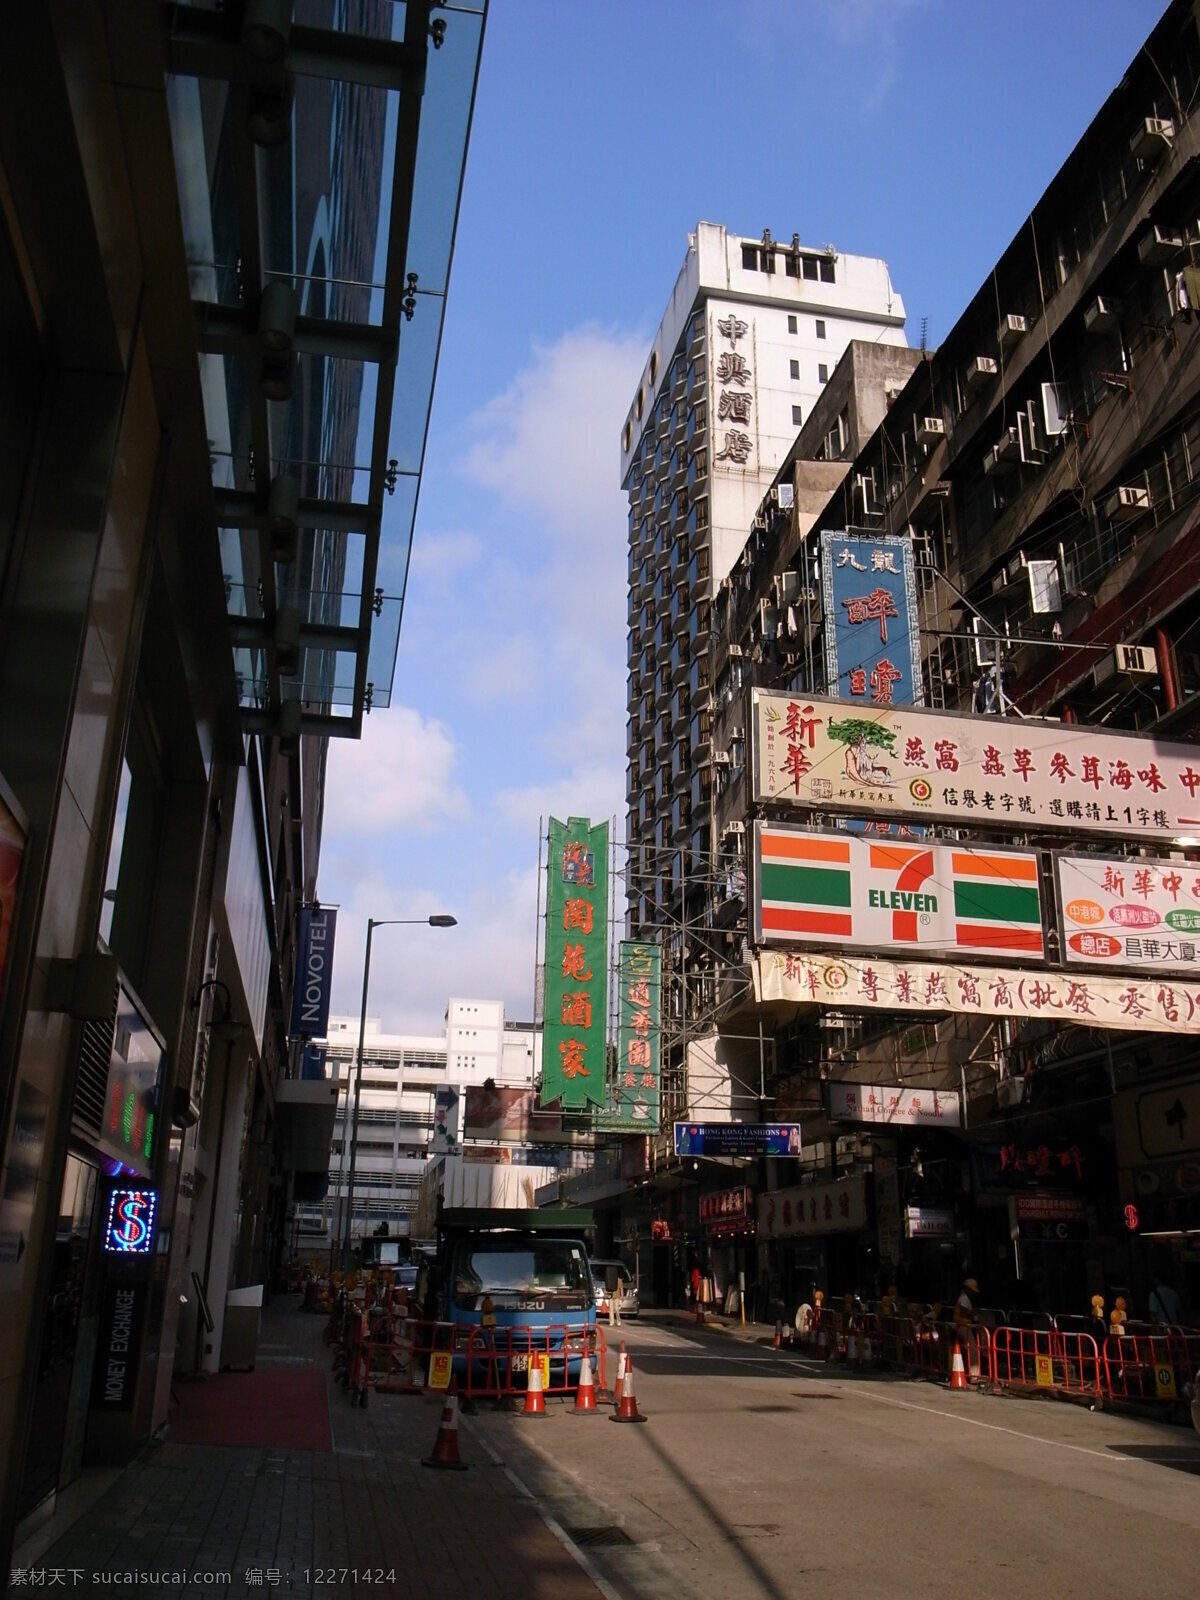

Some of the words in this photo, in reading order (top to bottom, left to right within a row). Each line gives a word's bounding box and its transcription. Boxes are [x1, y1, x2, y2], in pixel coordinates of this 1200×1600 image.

[779, 701, 823, 796] 新華
[903, 736, 960, 773] 燕窩
[981, 744, 1037, 783] 蟲草
[1049, 752, 1167, 794] 參茸海味
[1069, 905, 1101, 920] 中港城
[301, 914, 328, 1022] NOVOTEL
[1080, 935, 1111, 956] 總店
[1125, 937, 1200, 962] 昌華大廈
[782, 954, 822, 999] 新華
[846, 1104, 875, 1113] Nathan
[877, 1106, 906, 1117] Congee
[699, 1128, 722, 1136] HONG
[744, 1129, 780, 1137] FASHIONS
[110, 1288, 136, 1352] EXCHANGE
[504, 1300, 545, 1310] ISUZU
[103, 1358, 127, 1400] MONEY
